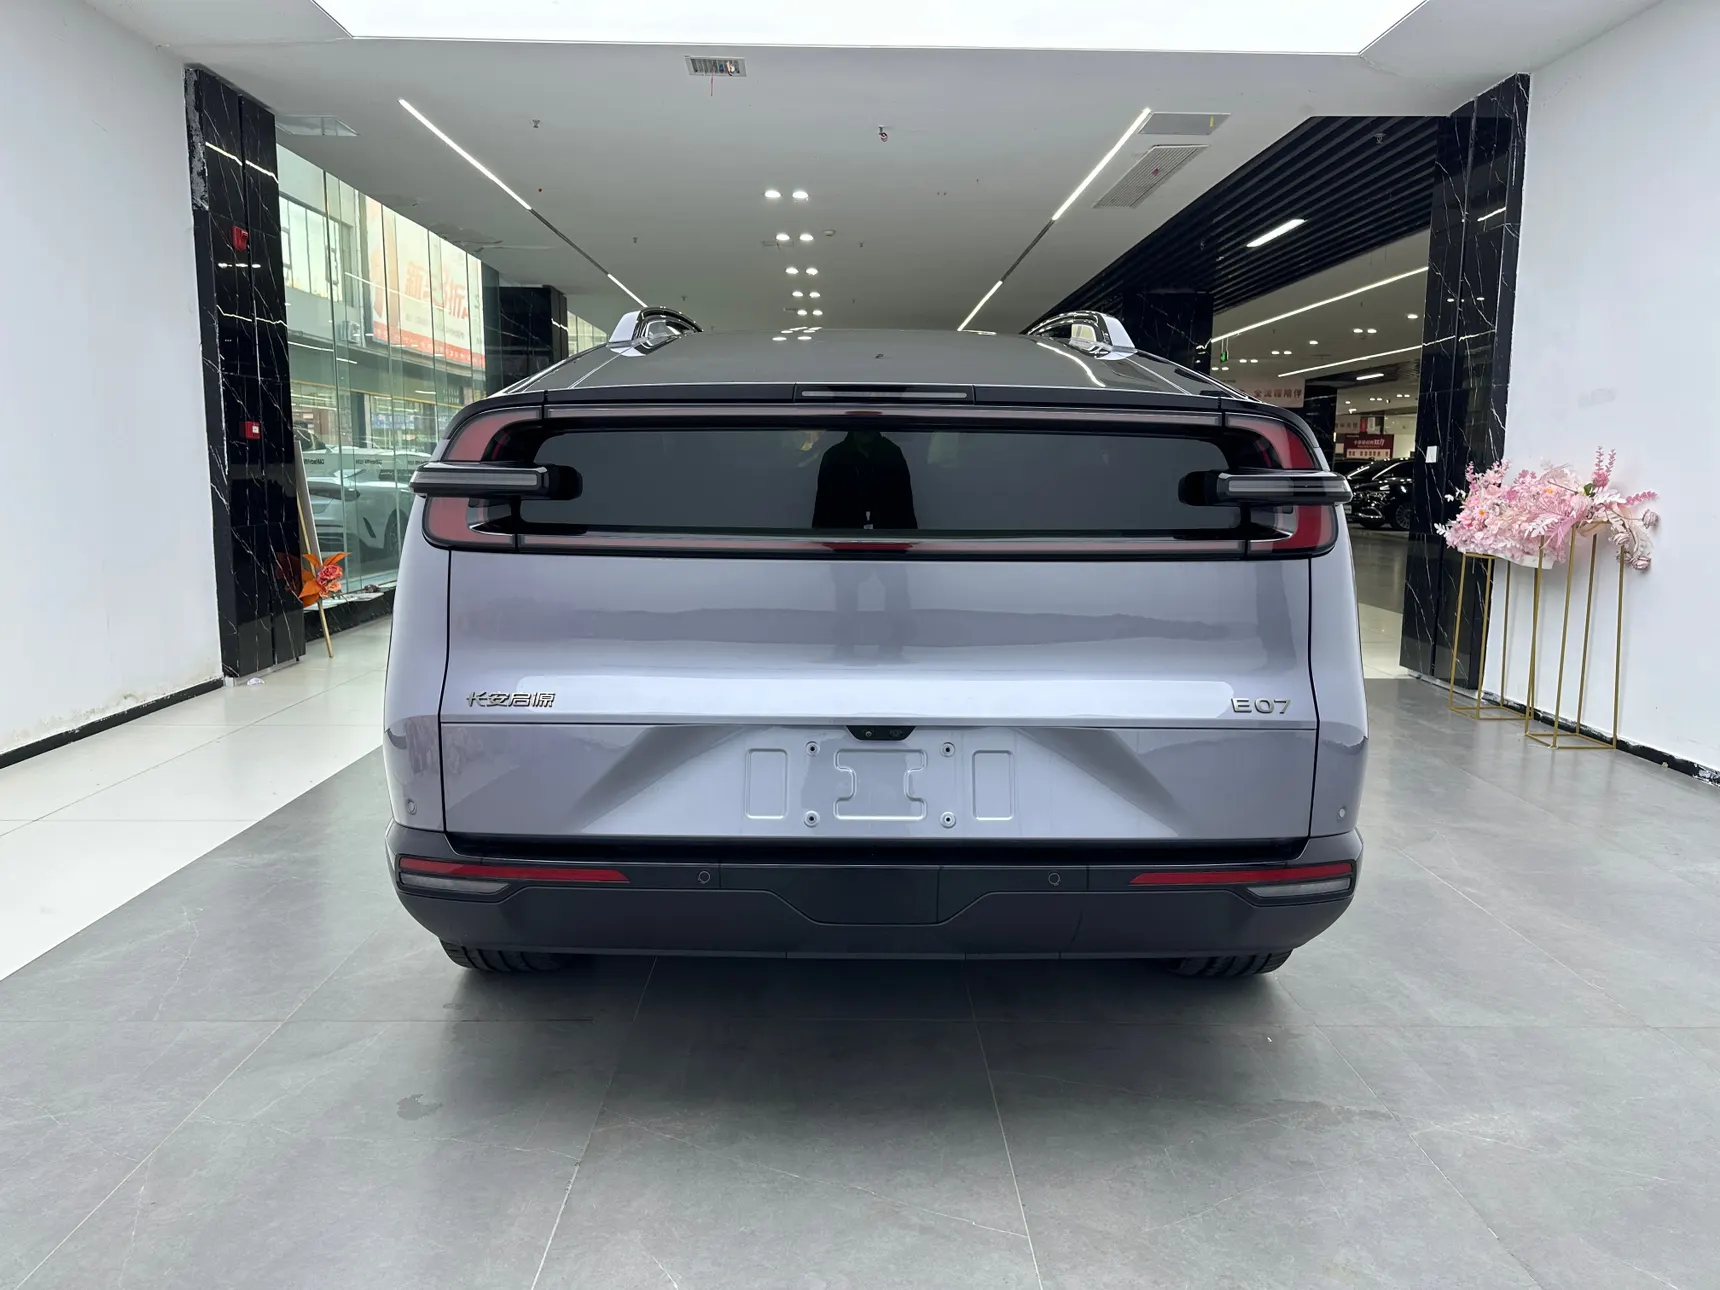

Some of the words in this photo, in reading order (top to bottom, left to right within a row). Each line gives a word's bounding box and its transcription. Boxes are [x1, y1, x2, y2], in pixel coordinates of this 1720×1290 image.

[466, 691, 556, 708] 长安启源
[1231, 698, 1291, 715] E07
